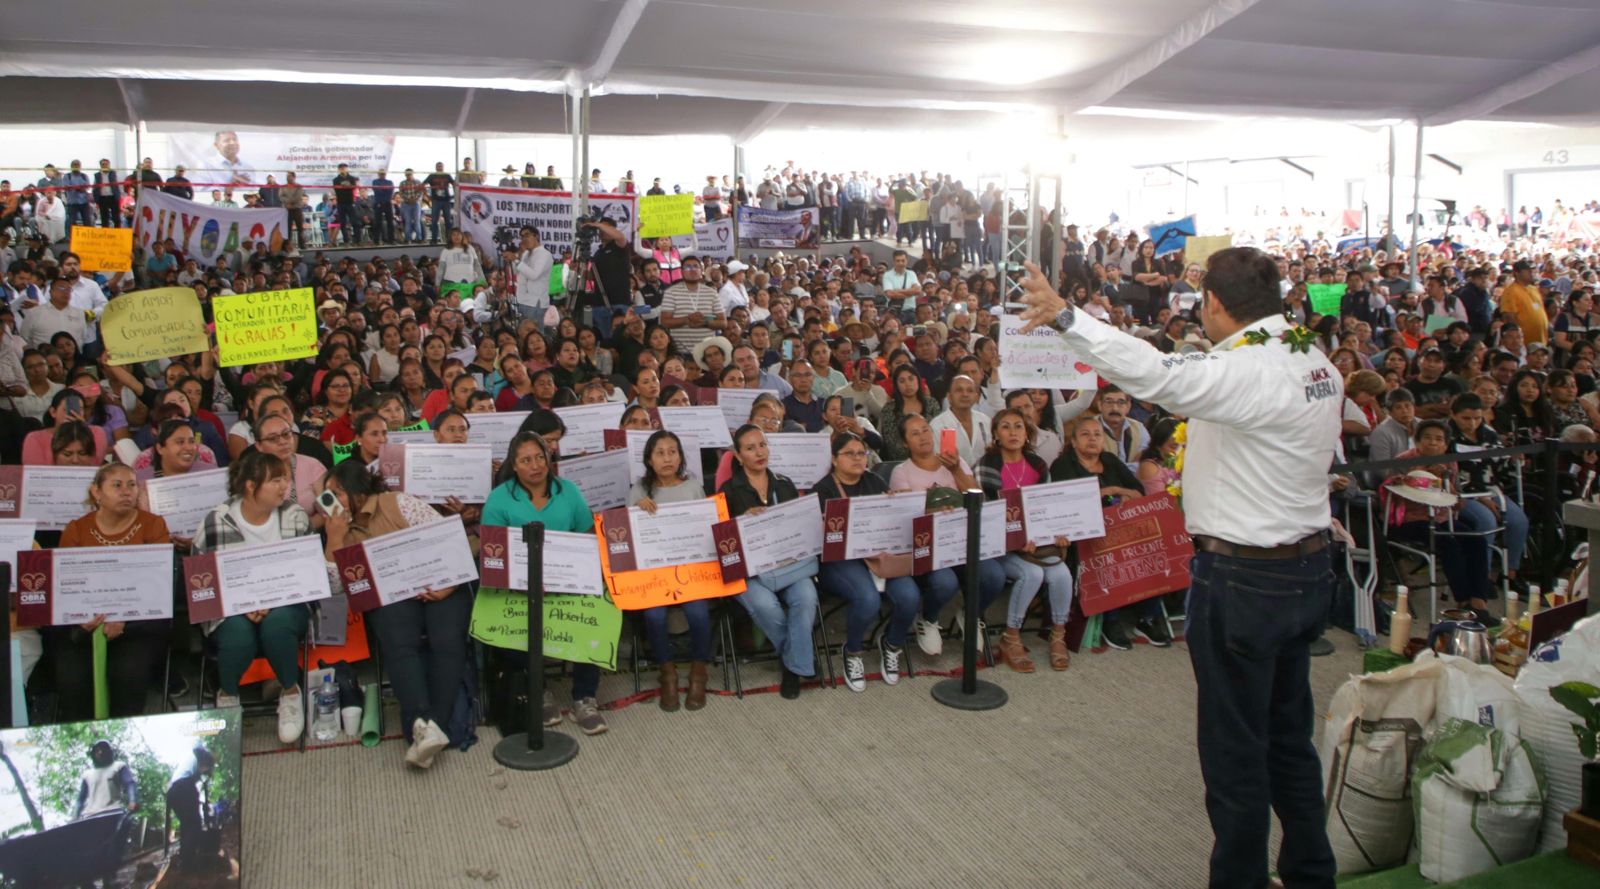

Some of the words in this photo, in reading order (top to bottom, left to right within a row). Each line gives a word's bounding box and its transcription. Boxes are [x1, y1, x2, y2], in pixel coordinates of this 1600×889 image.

[1543, 150, 1569, 164] 43
[496, 200, 513, 211] LOS
[493, 216, 503, 225] DE
[516, 217, 545, 227] REGIÓN
[541, 231, 552, 241] LA
[142, 294, 174, 307] AMOR
[246, 291, 291, 304] OBRA
[216, 303, 311, 323] COMUNITARIA
[121, 319, 195, 341] COMUNIDADES
[221, 347, 278, 363] GOBERNADOR
[1117, 497, 1175, 521] GOBERNADOR
[610, 544, 630, 552] OBRA
[1120, 538, 1168, 560] PRESENTE
[349, 582, 371, 592] OBRA
[20, 594, 46, 602] OBRA
[192, 590, 215, 599] OBRA
[549, 608, 599, 626] Abiertos
